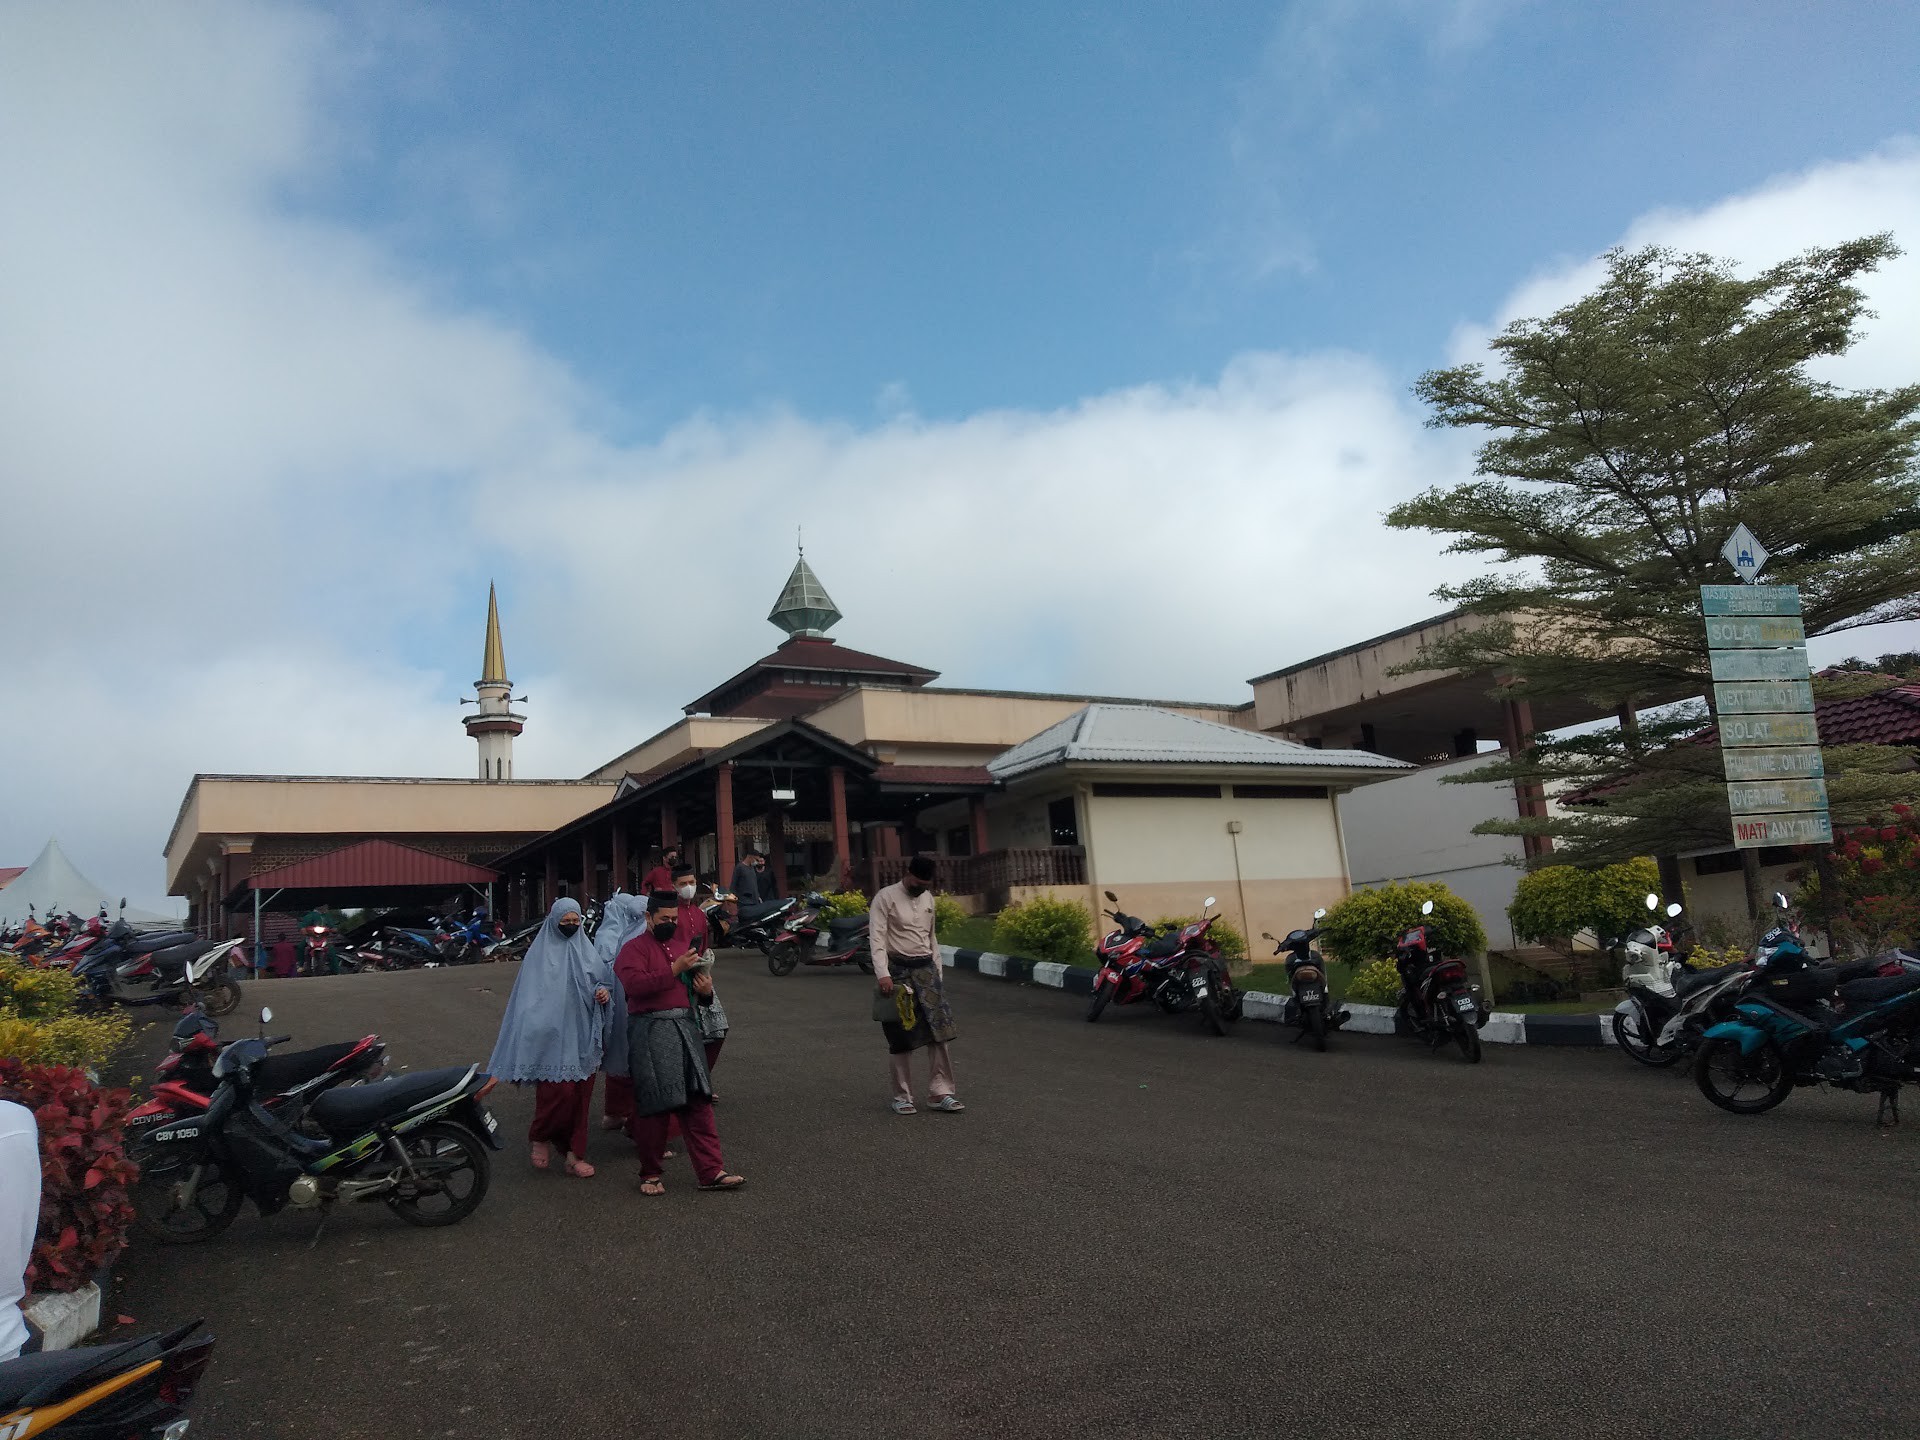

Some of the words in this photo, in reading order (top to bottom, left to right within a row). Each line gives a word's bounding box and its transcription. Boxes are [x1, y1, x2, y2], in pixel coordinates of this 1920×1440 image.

[1704, 587, 1727, 600] MASJID
[1729, 587, 1754, 600] SULTAN
[1755, 587, 1777, 600] AHMAD
[1712, 624, 1760, 641] SOLAT
[1720, 689, 1744, 706] NEXT
[1772, 689, 1786, 705] NO
[1787, 688, 1810, 705] TIME
[1725, 722, 1769, 739] SOLAT
[1729, 756, 1753, 773] FULL
[1782, 754, 1796, 771] ON
[1796, 753, 1819, 770] TIME
[1733, 789, 1762, 806] OVER
[1737, 822, 1768, 841] MATI
[1771, 821, 1796, 839] ANY
[1798, 819, 1828, 836] TIME
[155, 1130, 174, 1142] CBY
[176, 1127, 199, 1139] 1050
